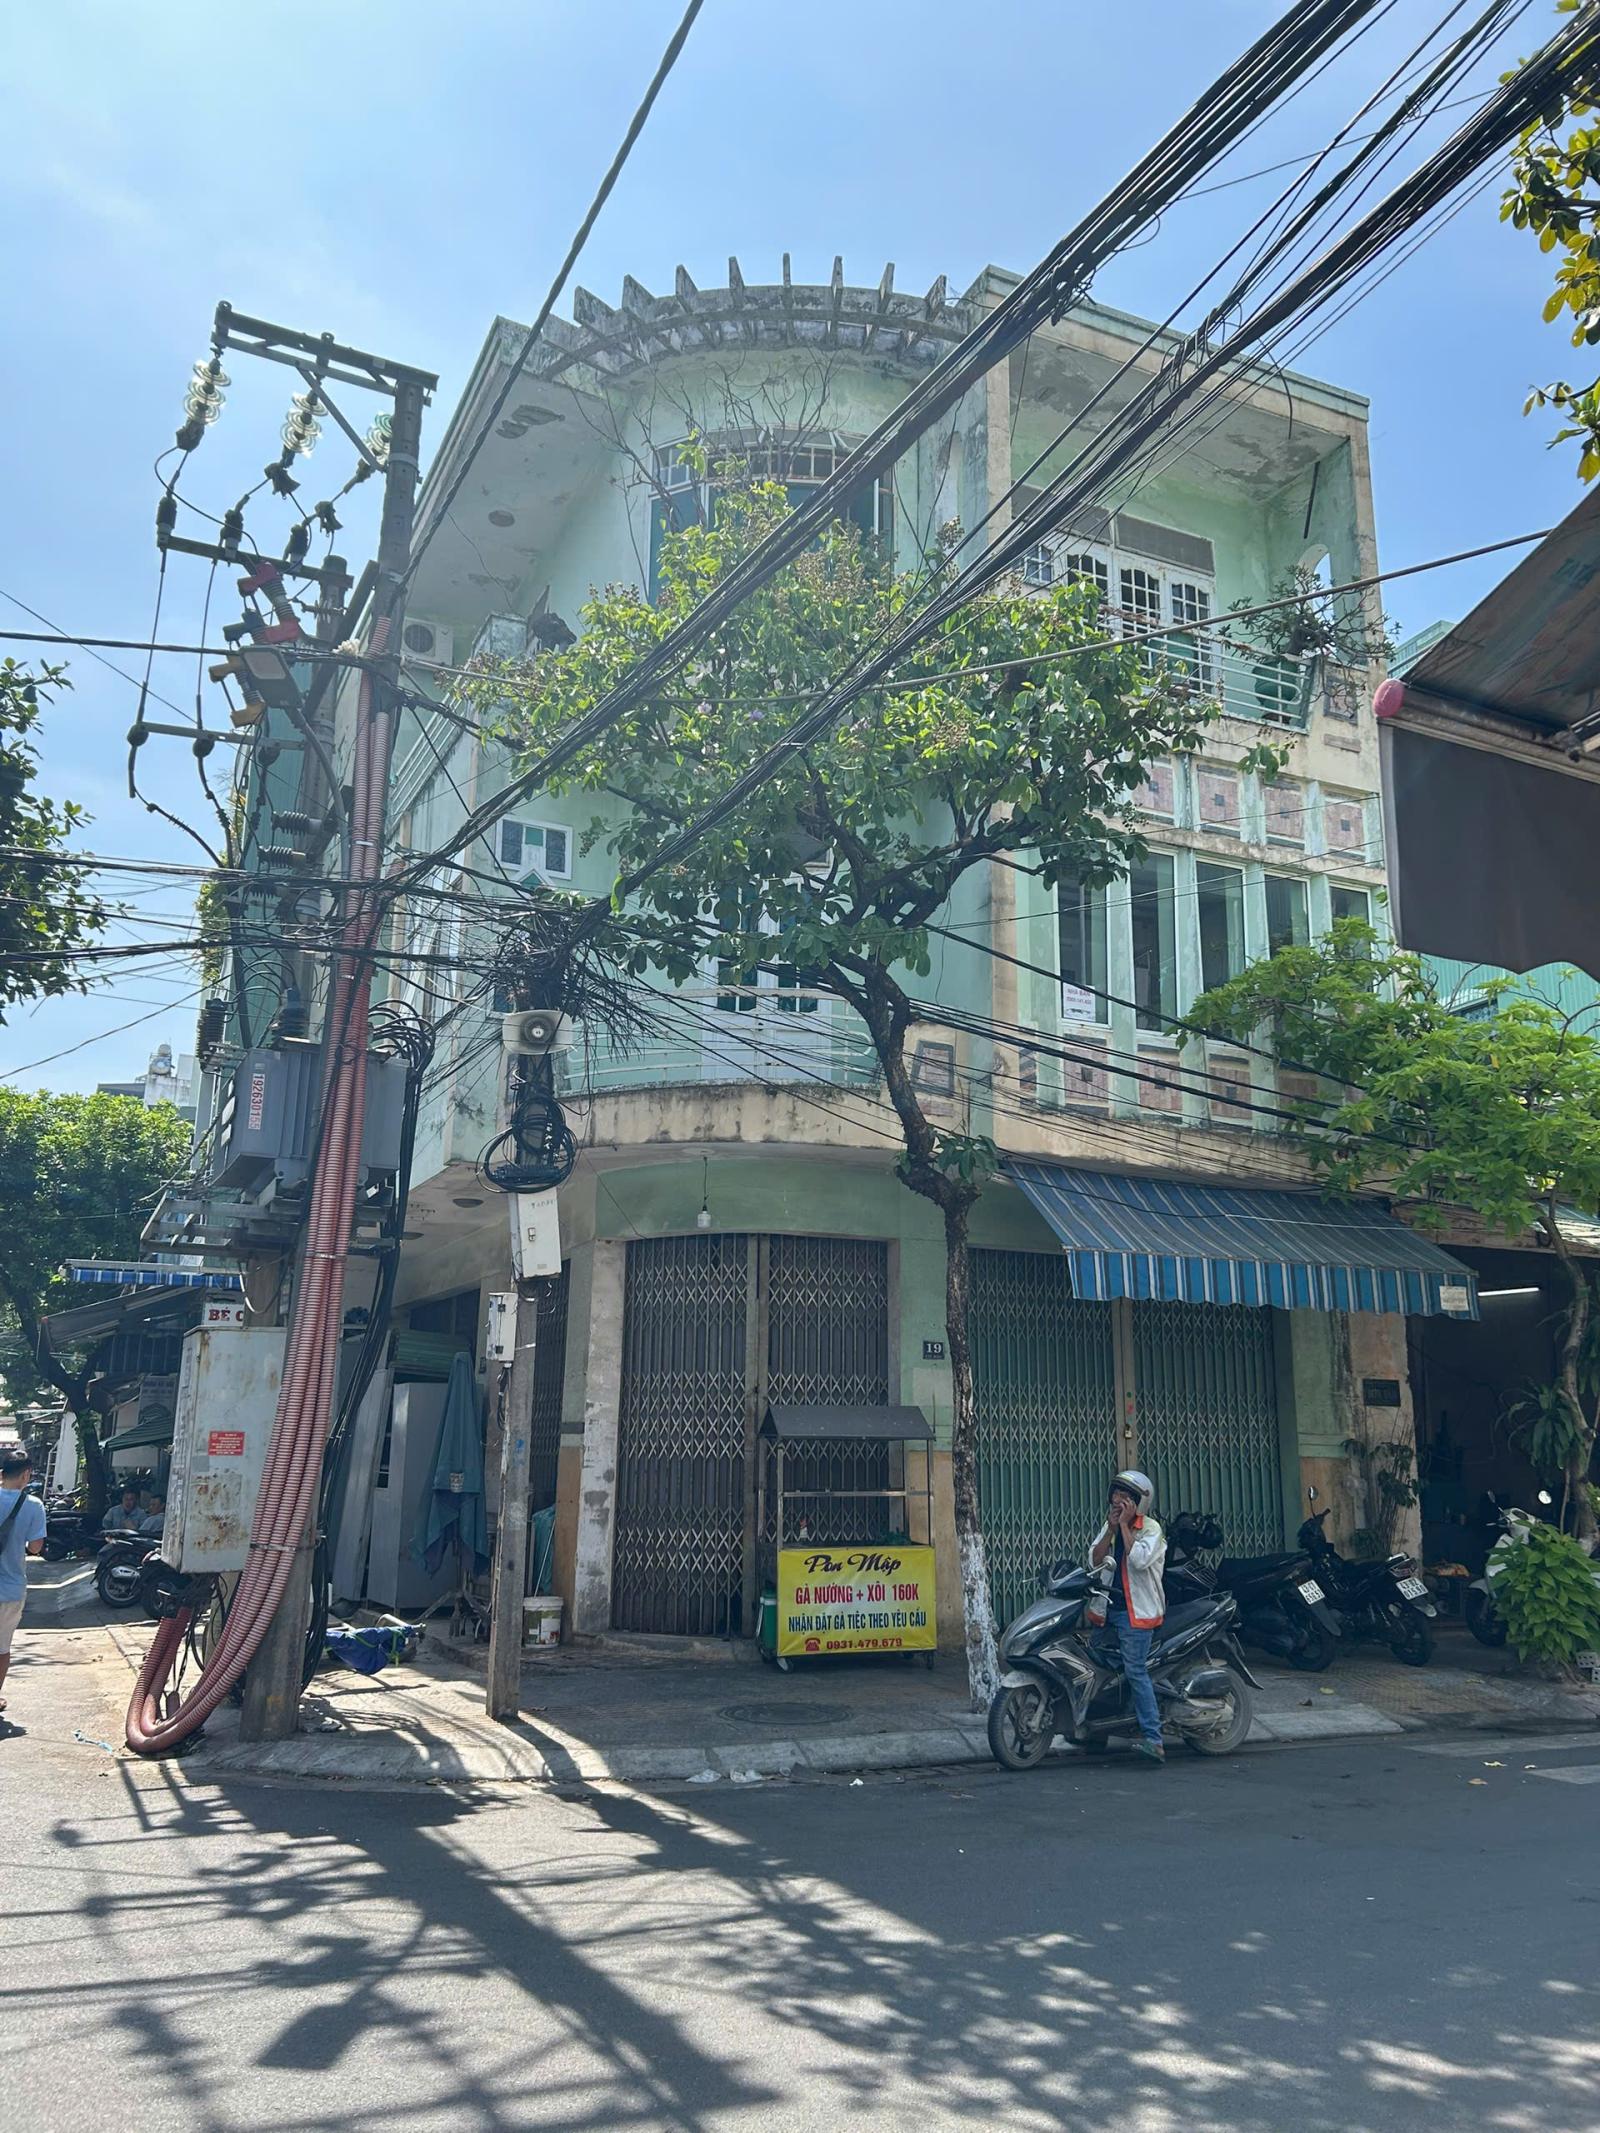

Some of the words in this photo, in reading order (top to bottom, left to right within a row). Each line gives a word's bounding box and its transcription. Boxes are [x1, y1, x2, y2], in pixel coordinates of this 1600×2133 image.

[926, 1343, 942, 1354] 19
[846, 1552, 902, 1577] Mập
[795, 1583, 811, 1605] GÀ
[814, 1582, 853, 1604] NƯỚNG
[856, 1589, 865, 1601] +
[866, 1580, 886, 1602] XÔI
[891, 1583, 919, 1601] 160K
[788, 1612, 813, 1635] NHẬN
[834, 1611, 846, 1630] GÀ
[847, 1610, 866, 1633] TIỆC
[868, 1612, 890, 1629] THEO
[891, 1608, 907, 1628] YÊU
